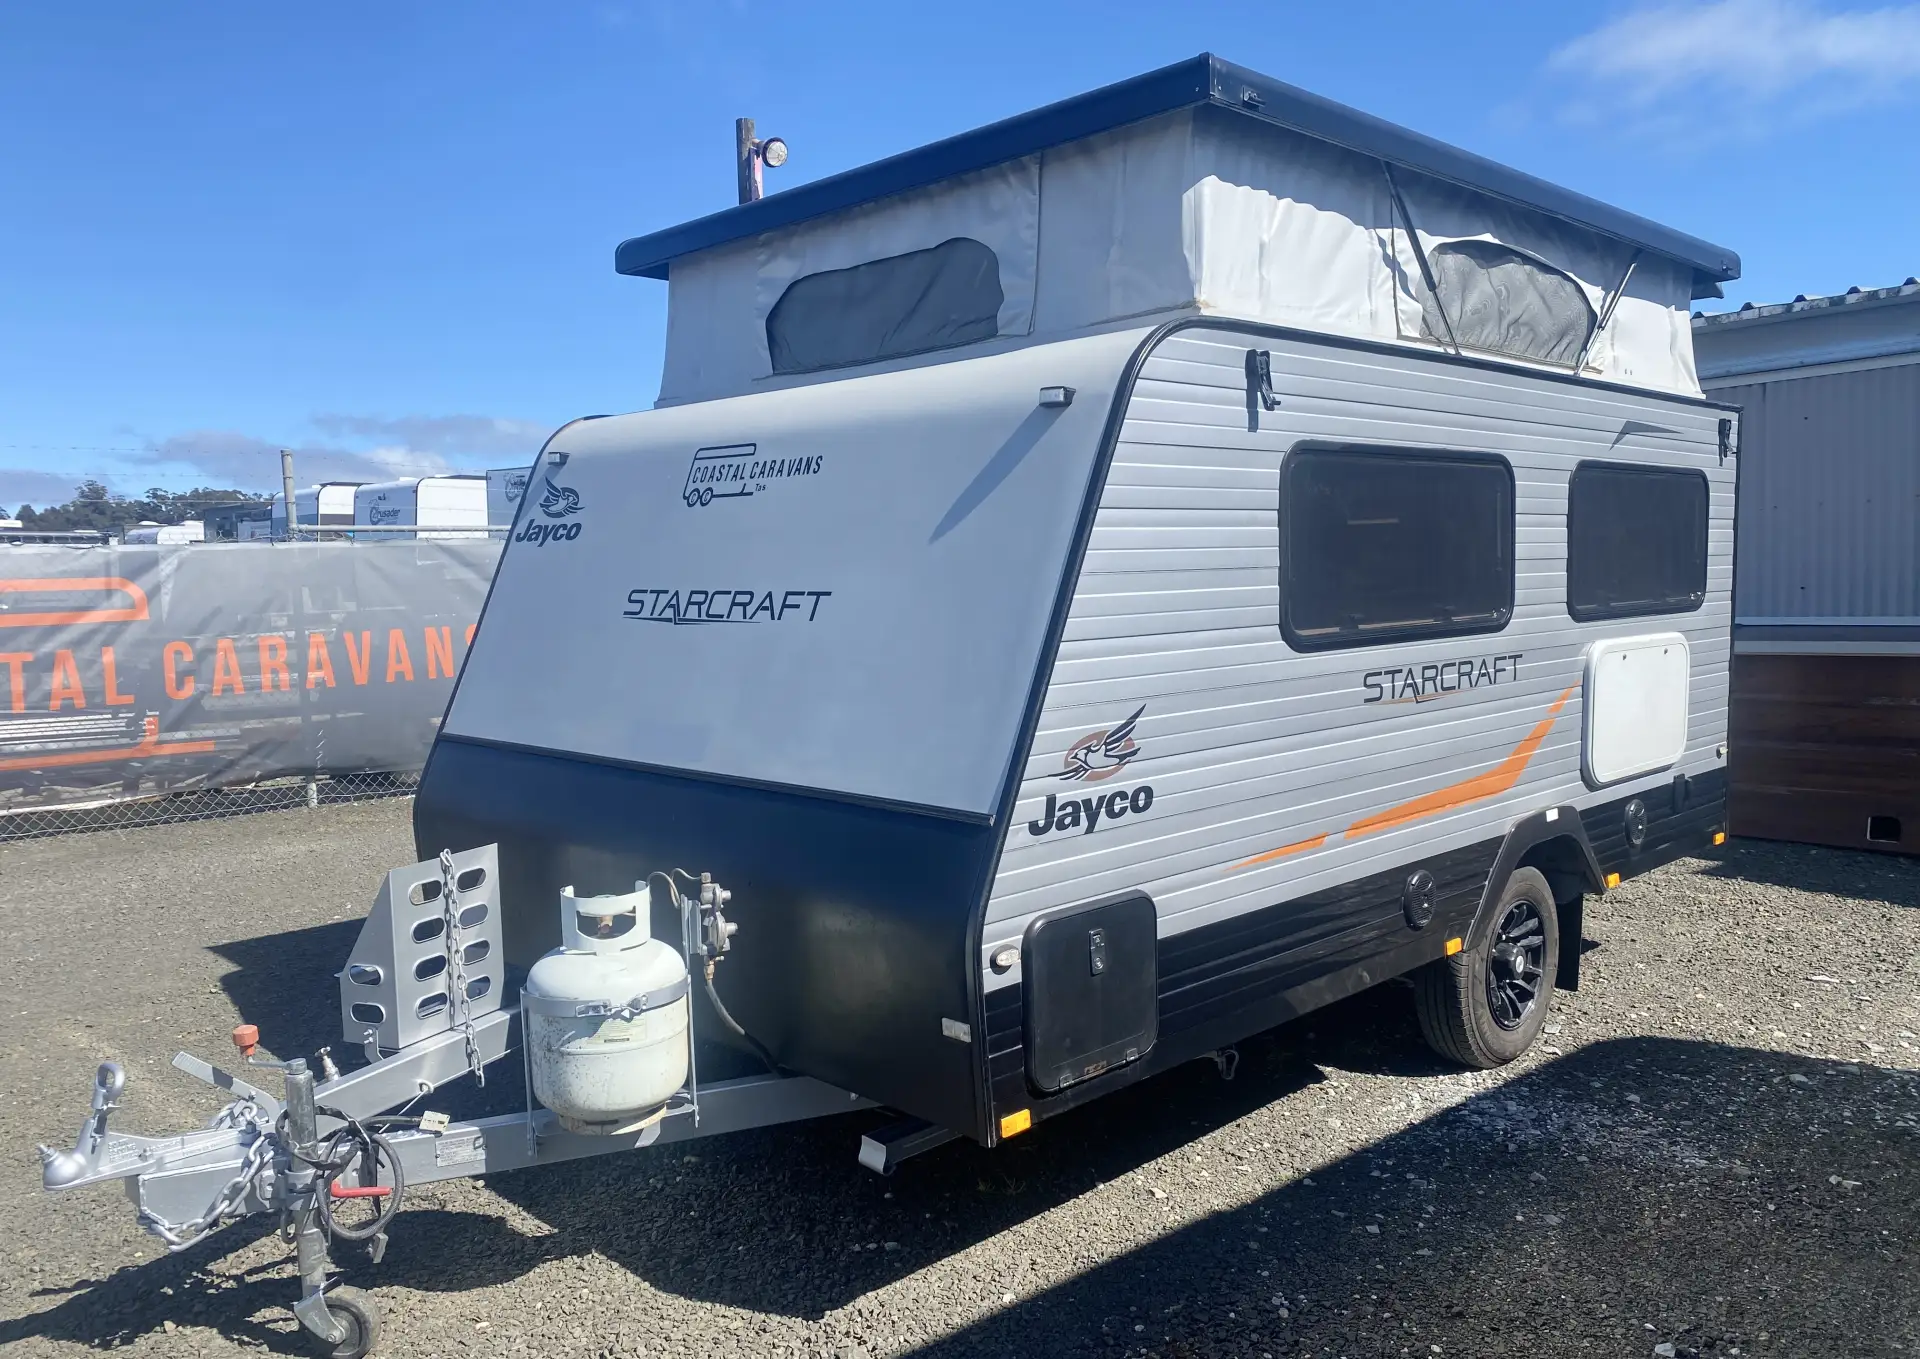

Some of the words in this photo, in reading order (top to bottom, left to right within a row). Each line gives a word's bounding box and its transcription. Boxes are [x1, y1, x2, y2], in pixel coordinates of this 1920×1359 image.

[692, 463, 746, 484] COASTAL
[749, 455, 823, 479] CARAVANS
[515, 518, 582, 547] Jayco
[622, 589, 832, 625] STARCRAFT
[1363, 653, 1523, 704] STARCRAFT
[1028, 785, 1154, 836] Jayco
